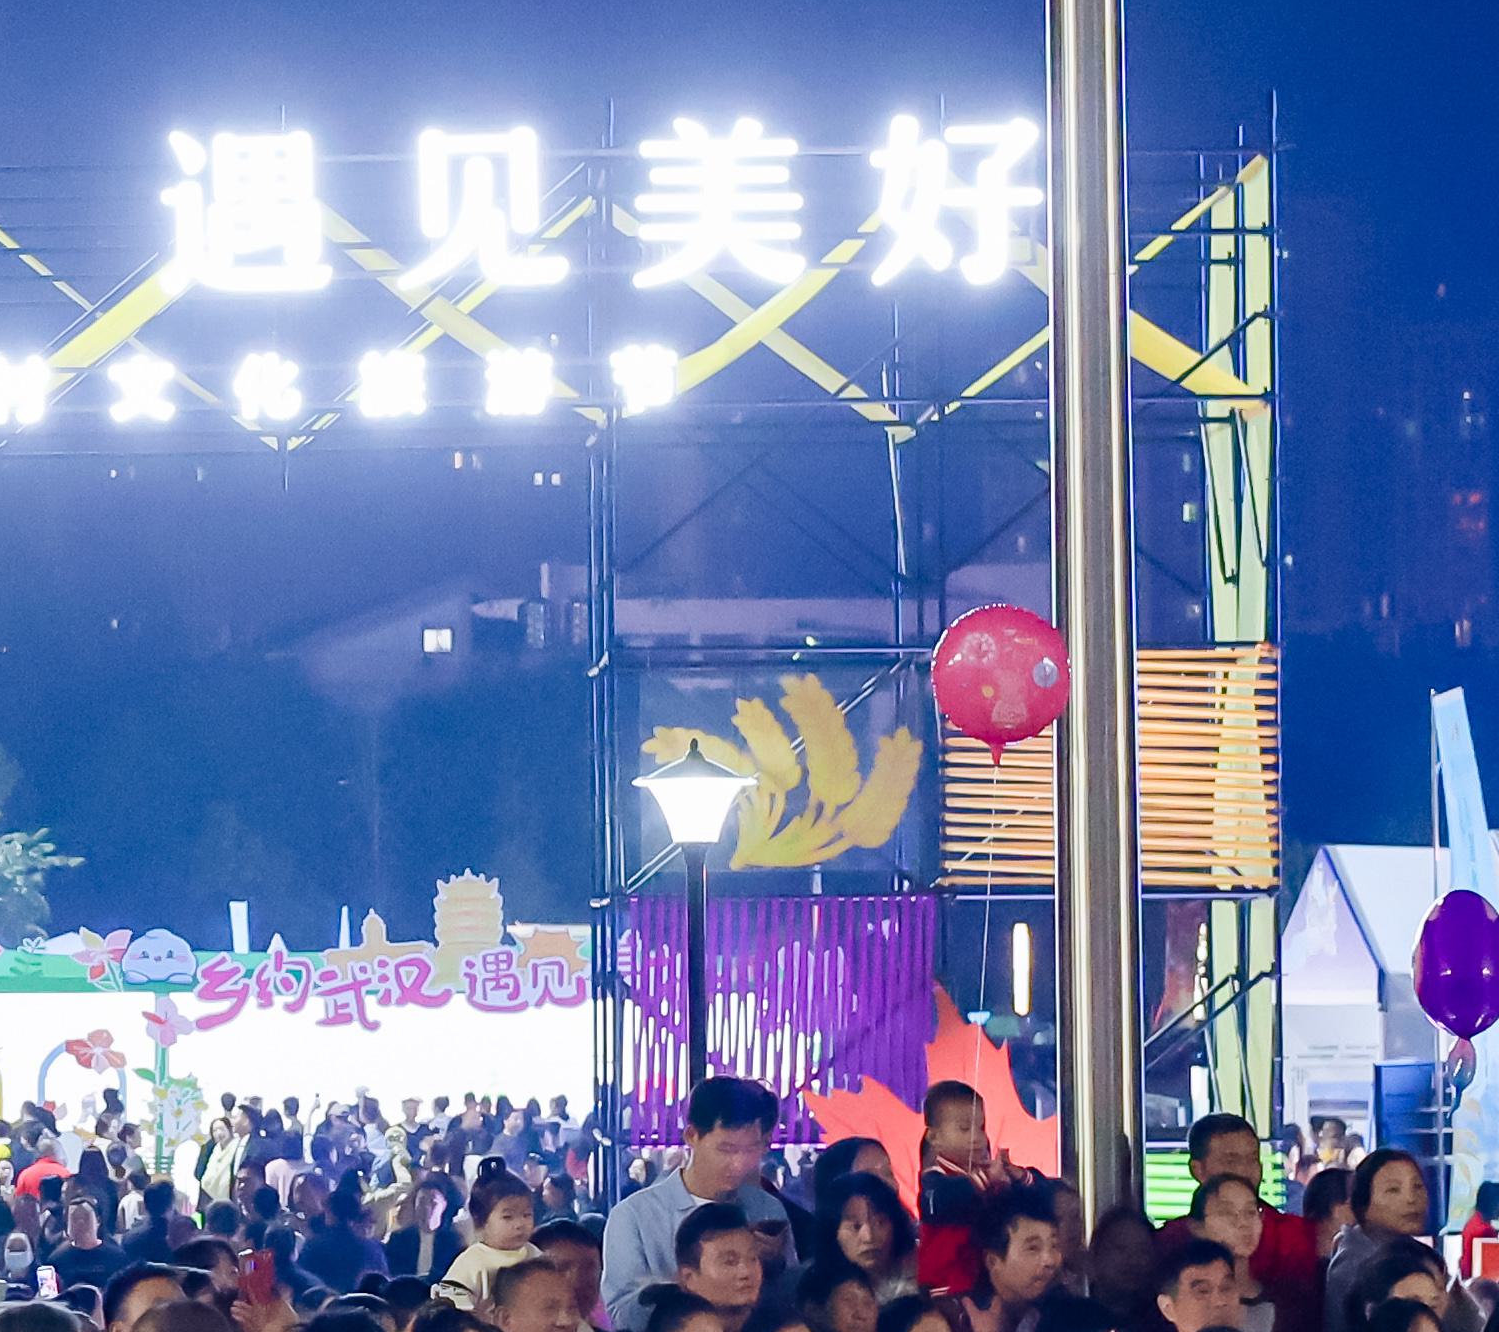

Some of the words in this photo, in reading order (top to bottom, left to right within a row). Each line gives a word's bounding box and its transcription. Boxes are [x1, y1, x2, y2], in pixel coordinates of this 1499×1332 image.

[156, 114, 1045, 292] 遇见美好
[193, 948, 454, 1030] 乡约武汉
